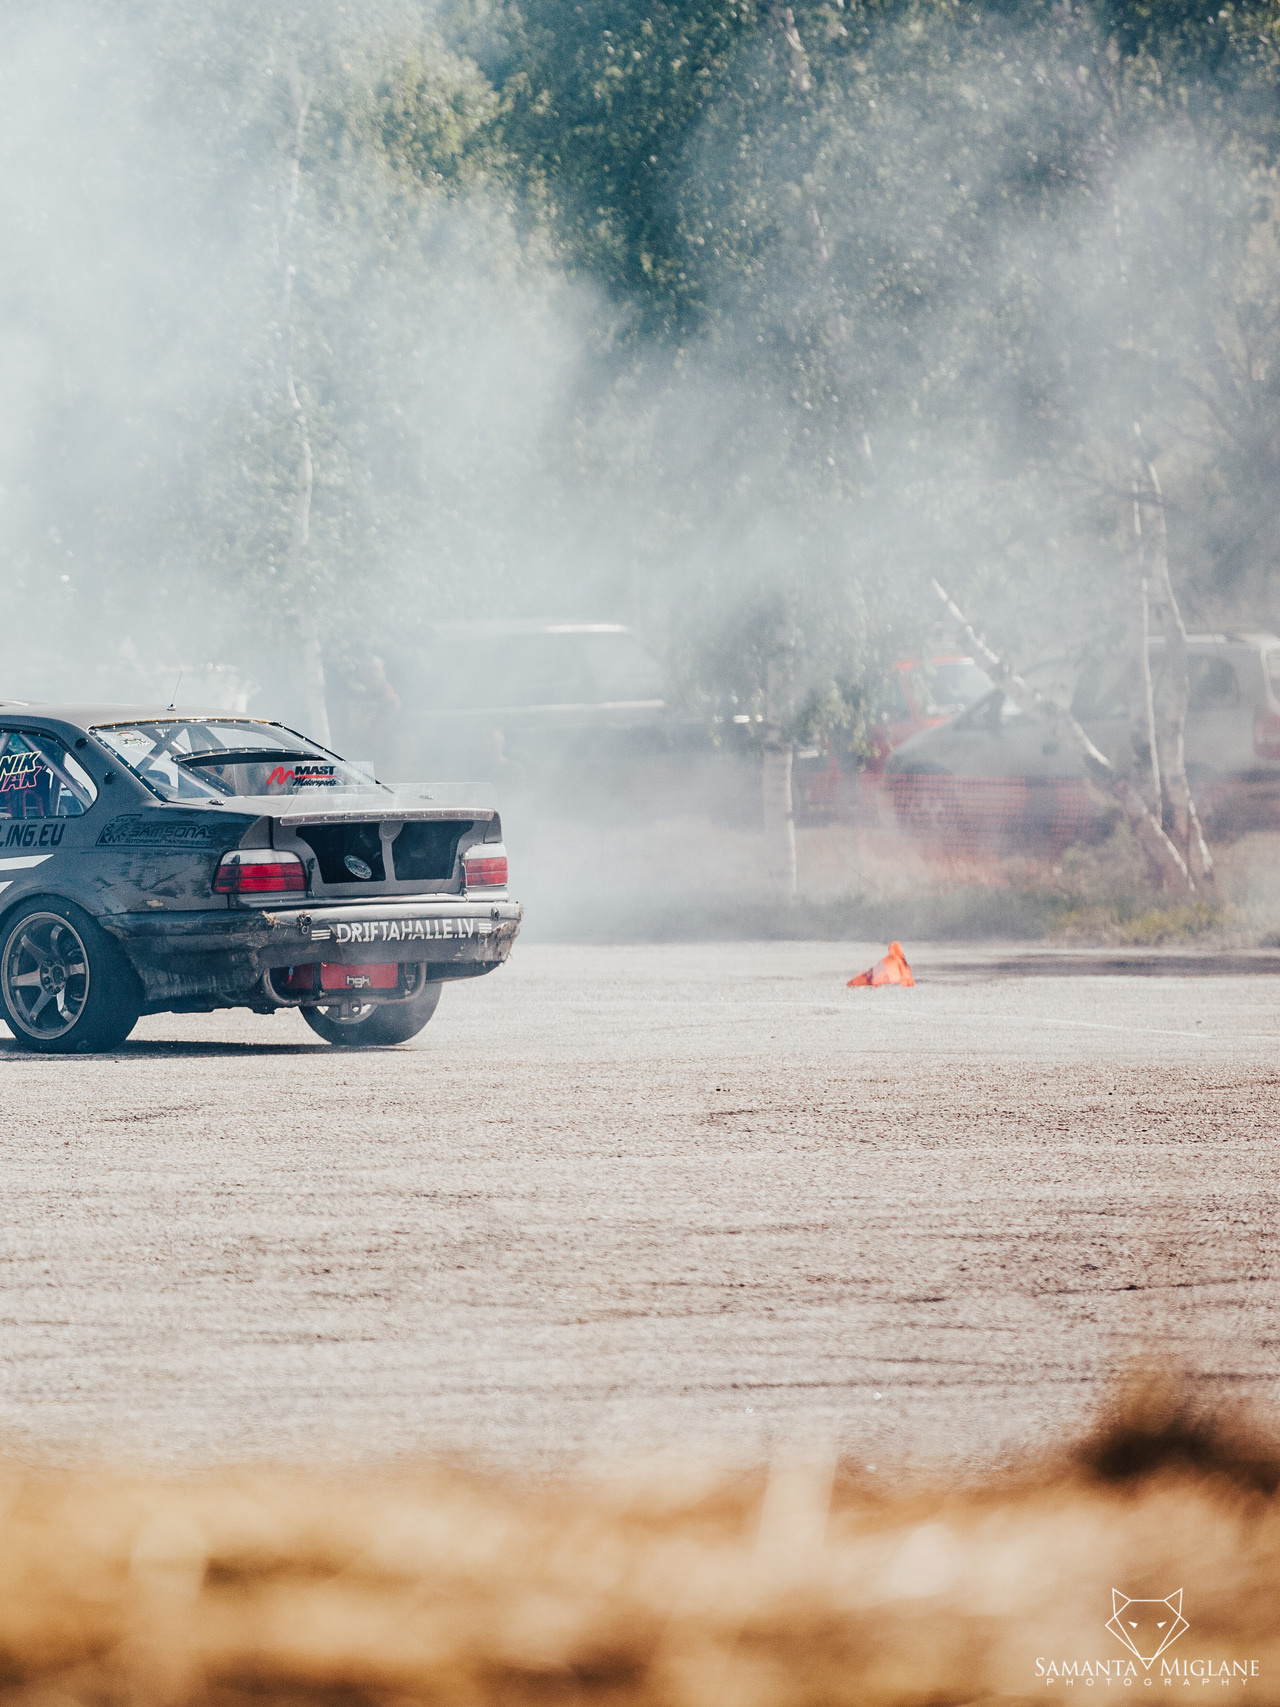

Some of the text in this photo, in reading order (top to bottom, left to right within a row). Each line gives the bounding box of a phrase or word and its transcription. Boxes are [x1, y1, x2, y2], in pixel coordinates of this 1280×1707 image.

[294, 765, 336, 776] MAST
[292, 777, 337, 787] Motorsports
[336, 918, 475, 943] DRIFTAHALLE.LV
[346, 975, 371, 988] hgk
